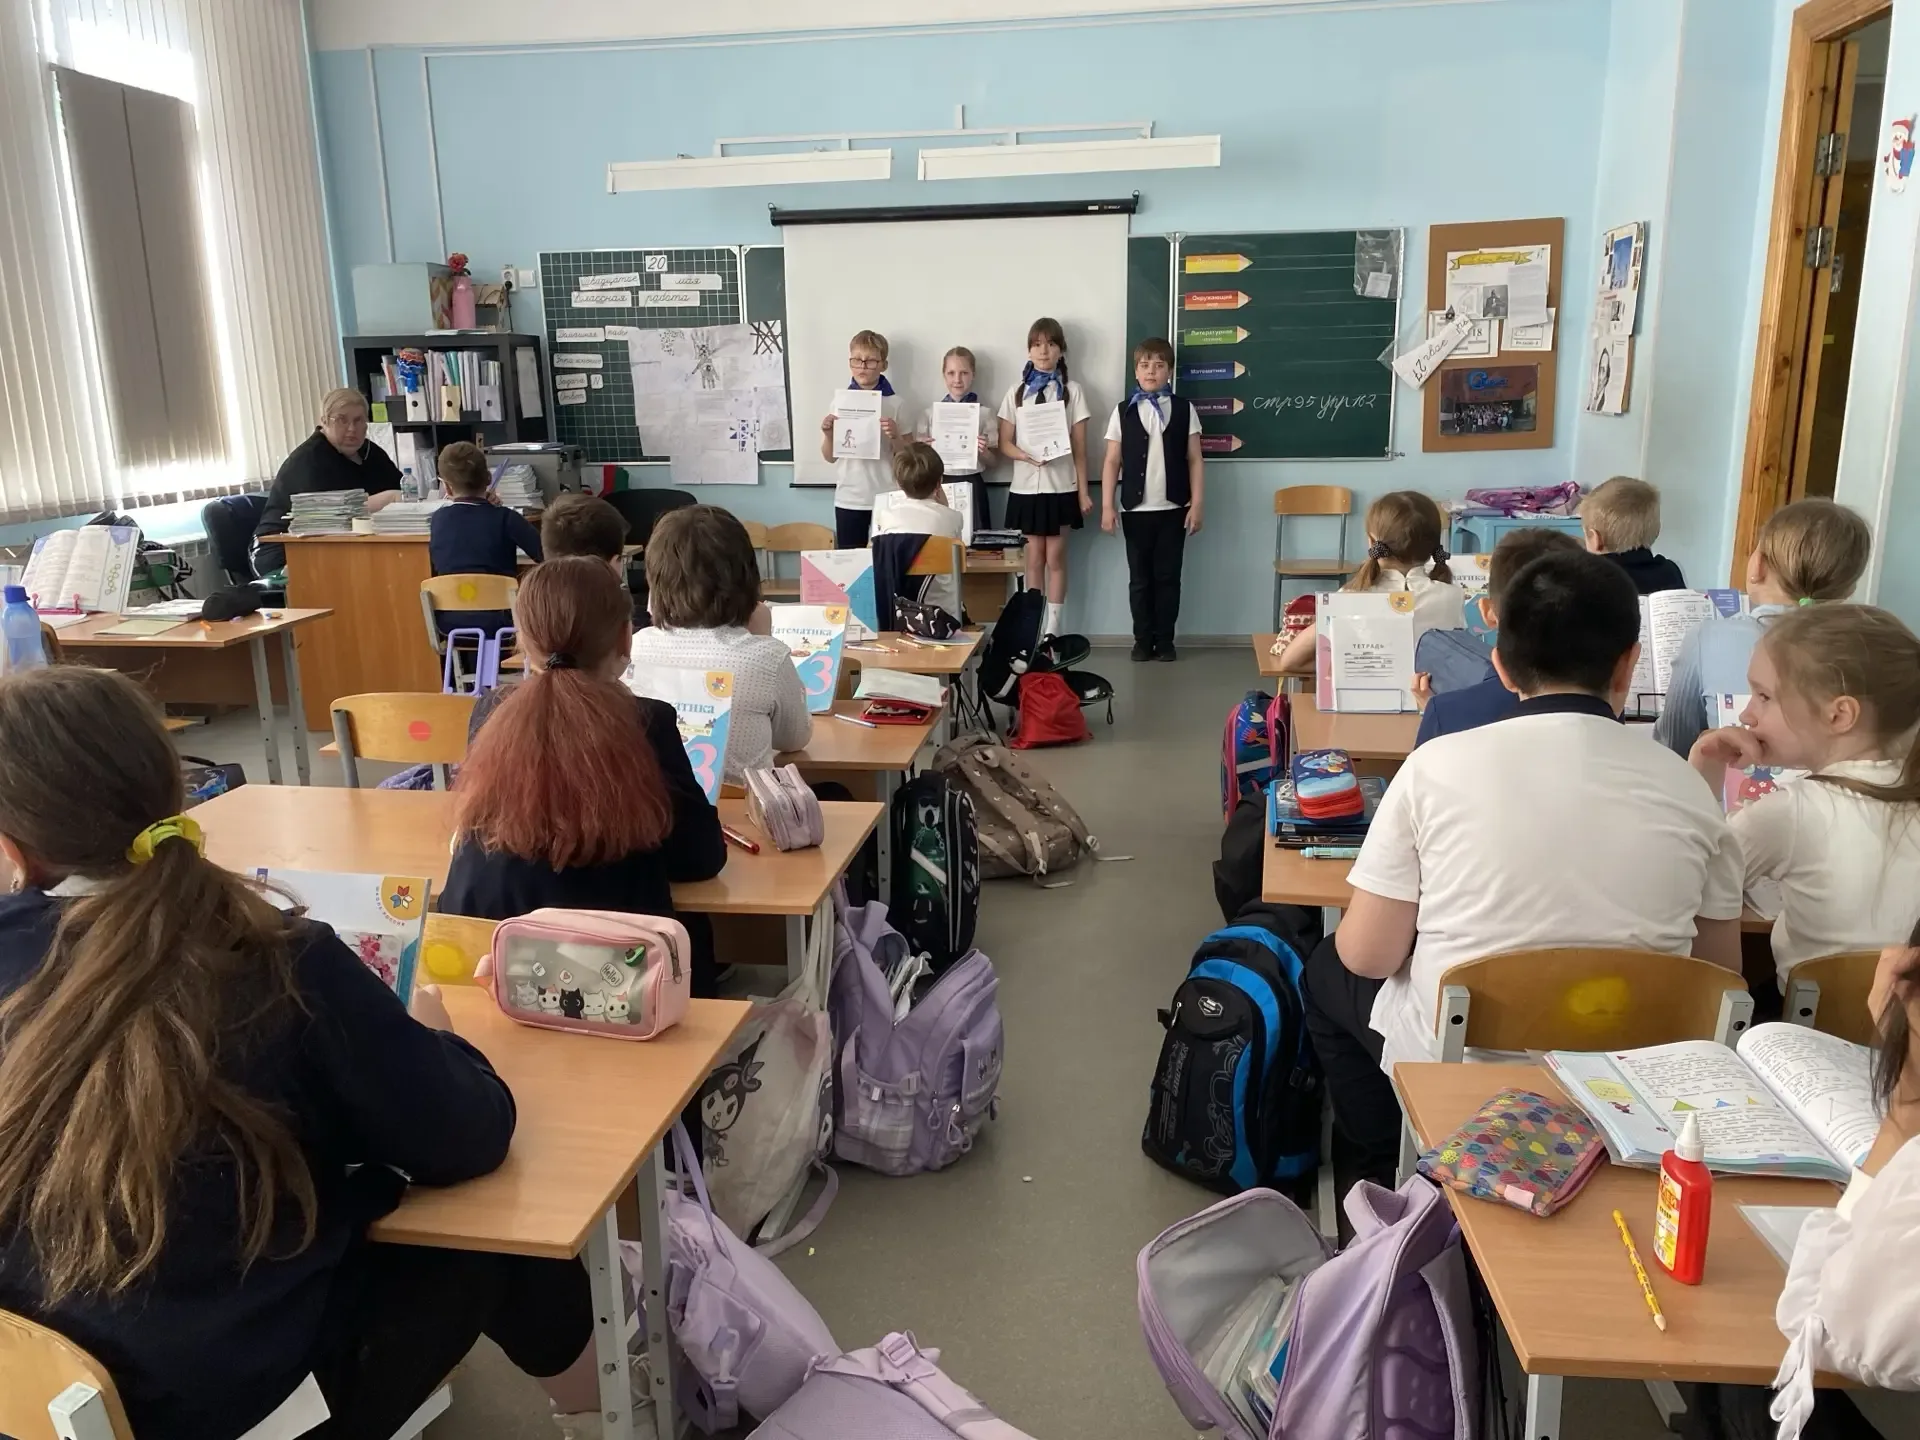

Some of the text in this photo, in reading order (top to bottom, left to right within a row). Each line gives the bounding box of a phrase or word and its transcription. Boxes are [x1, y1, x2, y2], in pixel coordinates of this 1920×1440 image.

[648, 256, 666, 270] 20
[675, 277, 701, 285] мая
[574, 290, 690, 307] Классная работа
[1294, 395, 1317, 409] 95
[602, 964, 620, 985] Hello!
